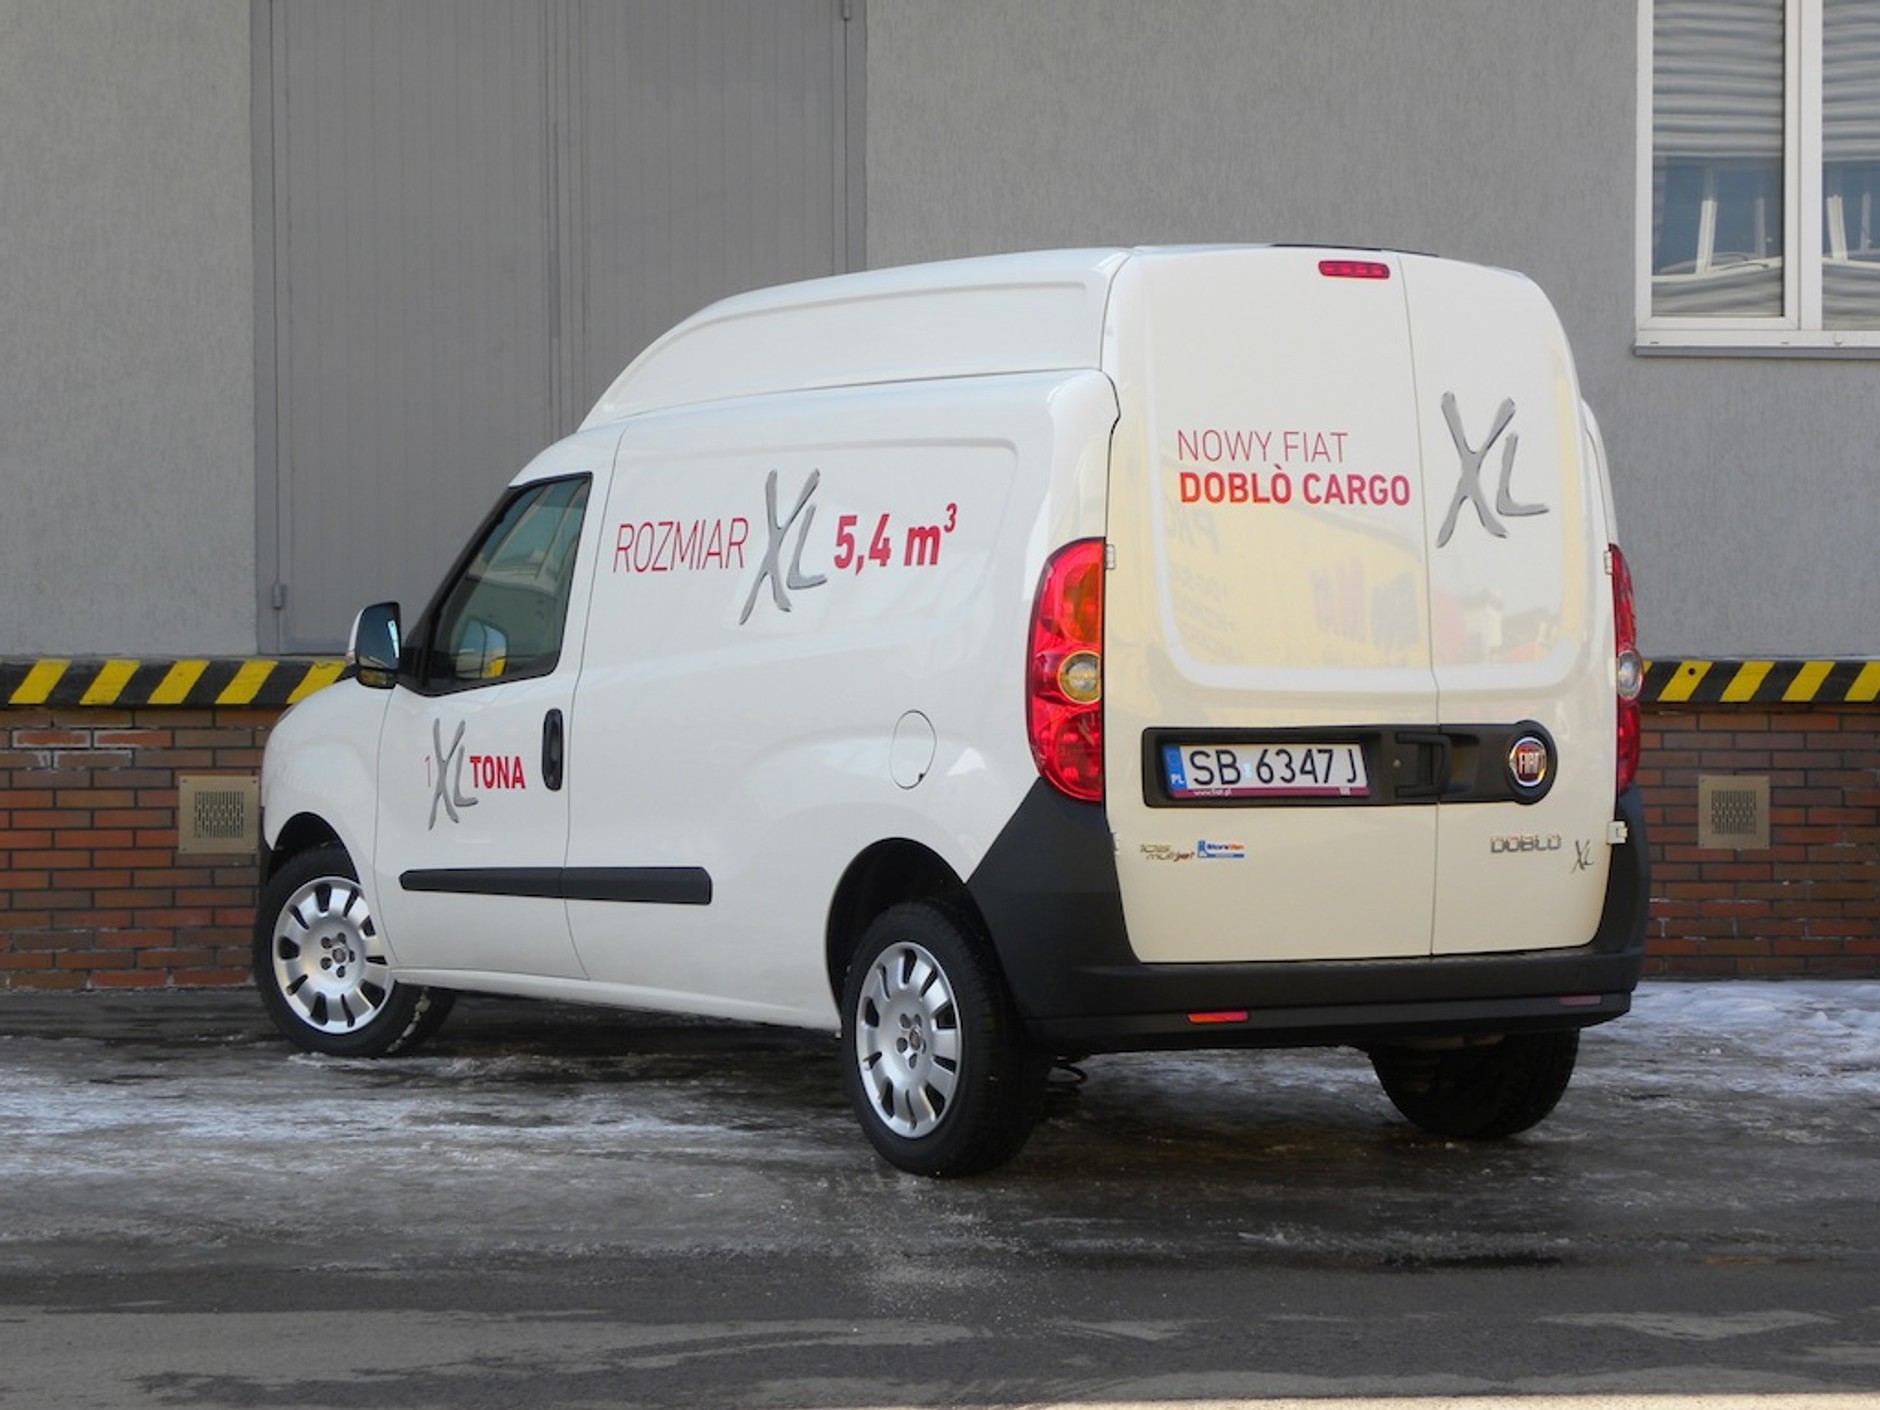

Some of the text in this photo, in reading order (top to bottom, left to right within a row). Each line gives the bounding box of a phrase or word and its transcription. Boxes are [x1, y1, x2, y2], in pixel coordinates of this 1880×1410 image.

[1177, 429, 1349, 463] NOWY FIAT
[1179, 464, 1411, 506] DOBLÒ CARGO
[1436, 391, 1550, 548] XL
[613, 517, 749, 573] ROZMIAR
[739, 468, 828, 626] XL
[833, 513, 892, 575] 5,4
[428, 718, 479, 831] XL
[469, 755, 526, 789] TONA
[1170, 773, 1184, 785] PL
[1189, 748, 1242, 786] SB
